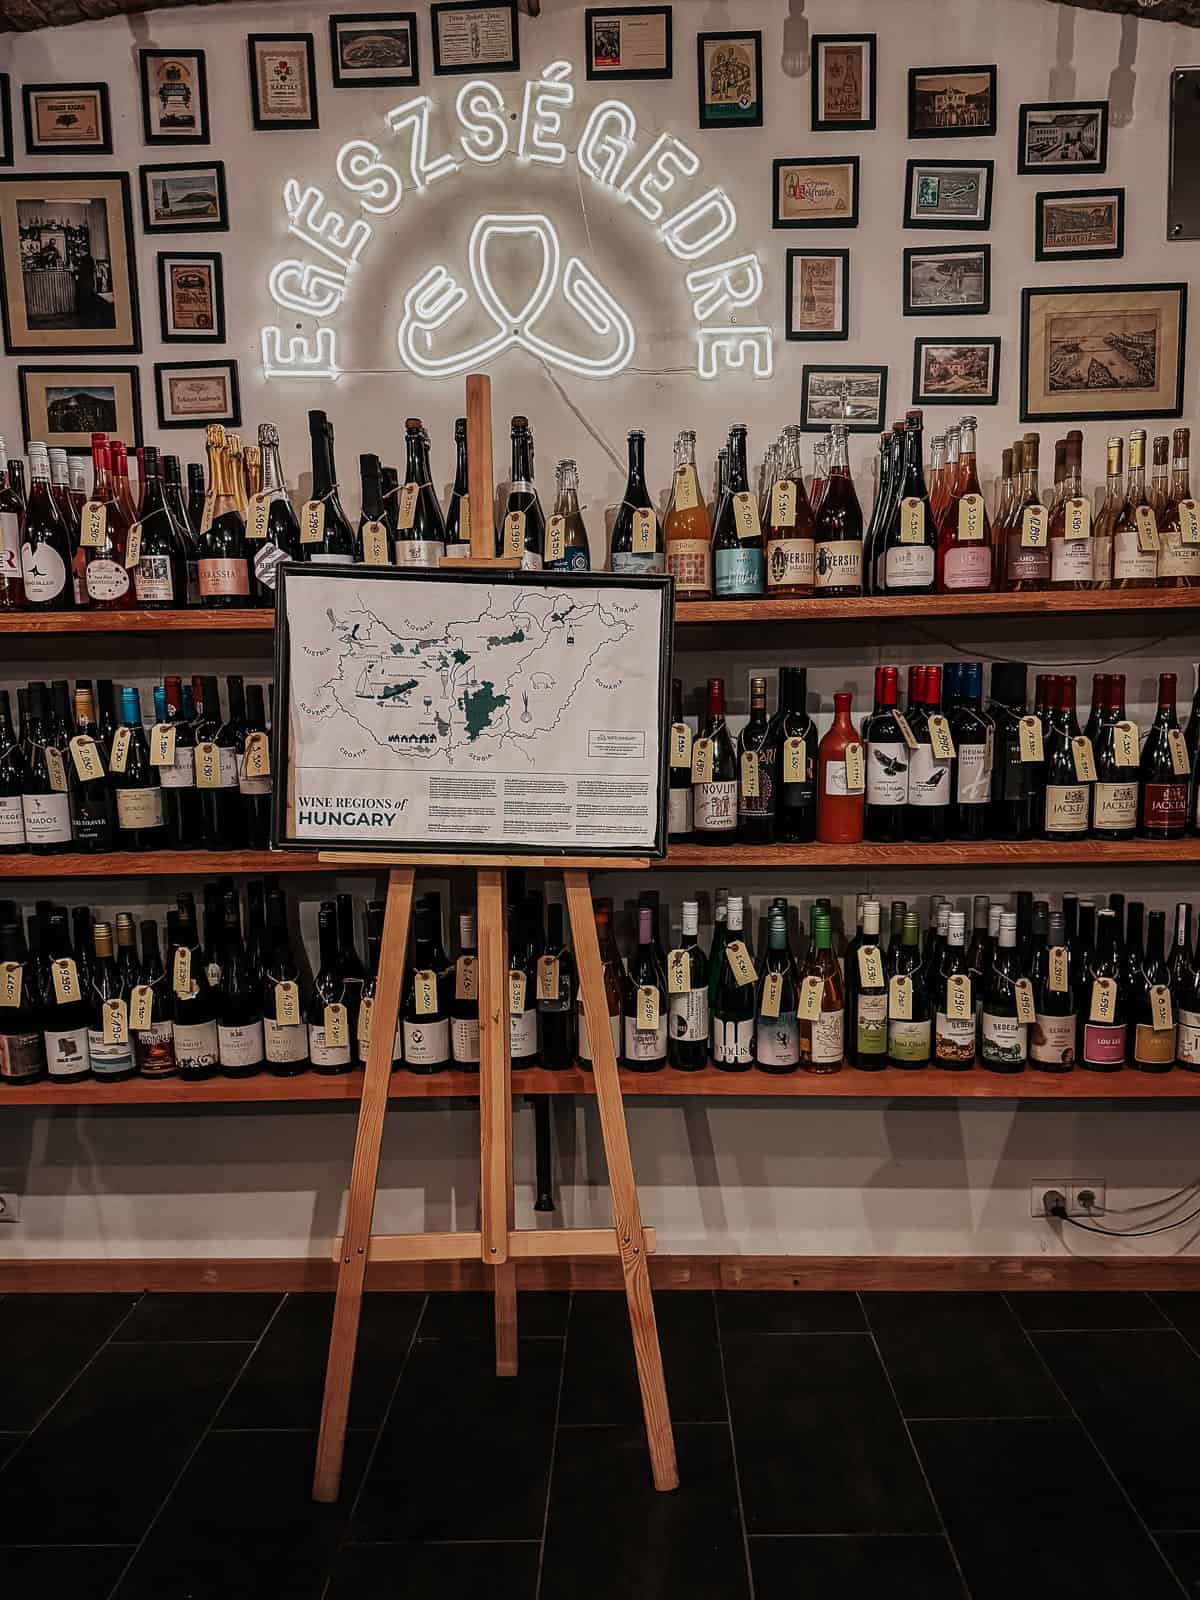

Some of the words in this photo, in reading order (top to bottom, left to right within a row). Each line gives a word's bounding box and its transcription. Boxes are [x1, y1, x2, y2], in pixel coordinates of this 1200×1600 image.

[262, 61, 774, 379] EGÉSZSÉGEDRE
[302, 646, 331, 656] AUSTRIA
[595, 678, 622, 688] ROMANIA
[300, 702, 330, 715] SLOVENIA
[340, 747, 367, 757] CROATIA
[298, 796, 333, 809] WINE
[336, 798, 392, 810] REGIONS
[394, 798, 409, 811] of
[298, 811, 397, 827] HUNGARY
